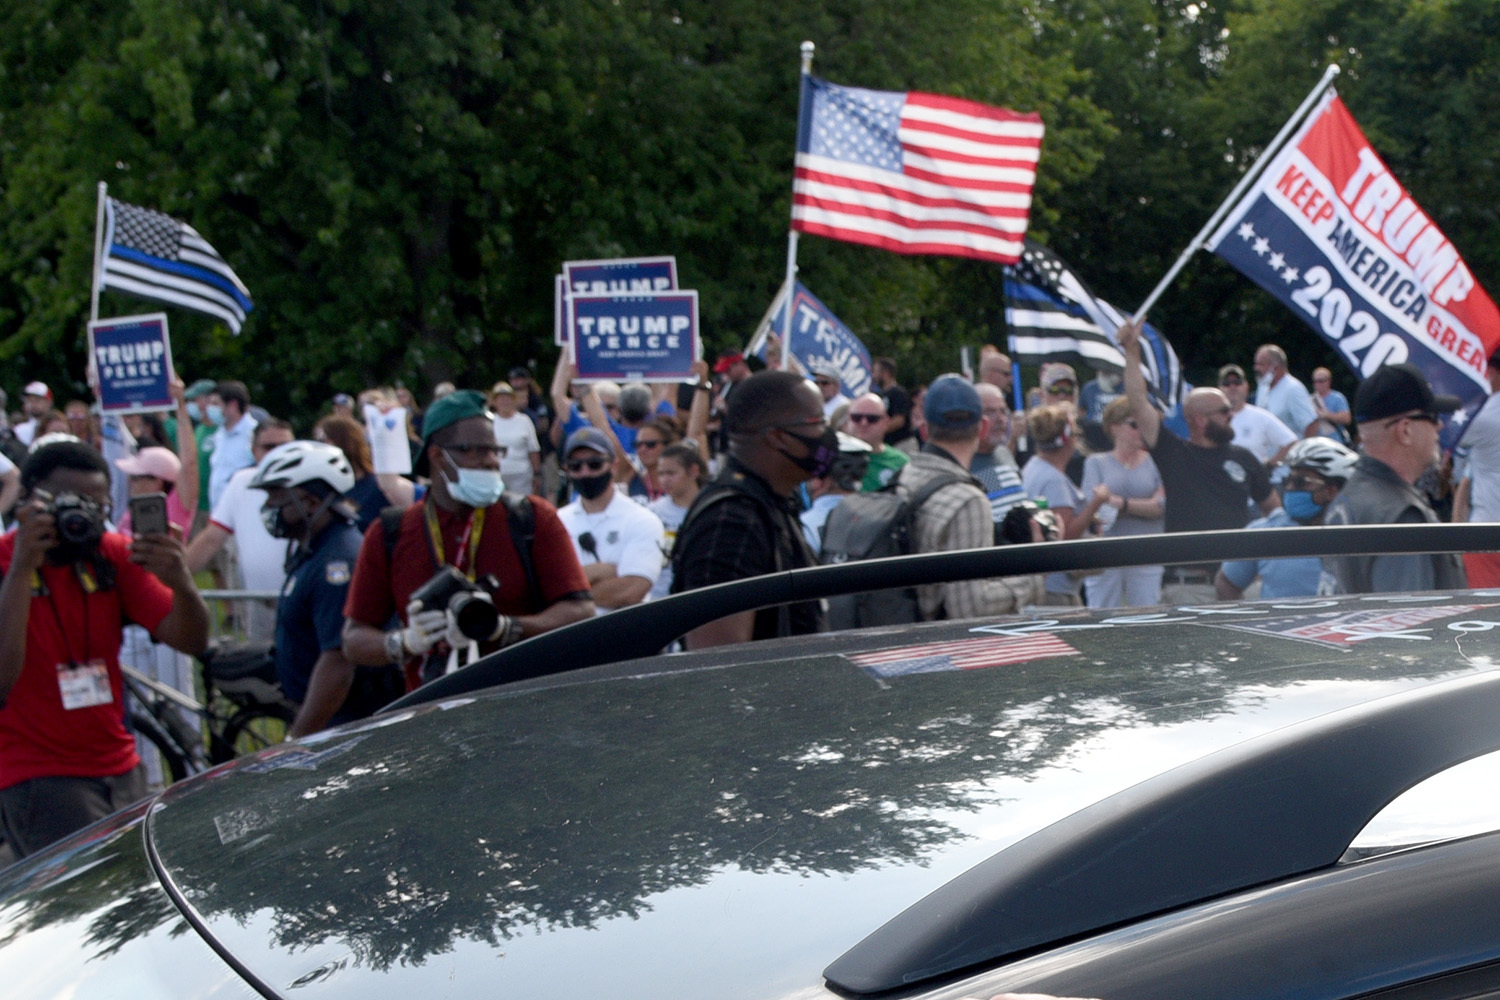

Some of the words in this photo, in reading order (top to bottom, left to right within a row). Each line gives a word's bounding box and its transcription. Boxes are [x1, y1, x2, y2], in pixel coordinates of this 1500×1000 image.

[1340, 146, 1474, 307] TRUMP
[1275, 163, 1336, 226] KEEP
[1327, 217, 1428, 325] AMERICA
[577, 315, 690, 336] TRUMP
[1290, 265, 1409, 380] 2020
[96, 340, 164, 365] TRUMP
[587, 335, 680, 349] PENCE
[103, 361, 161, 379] PENCE
